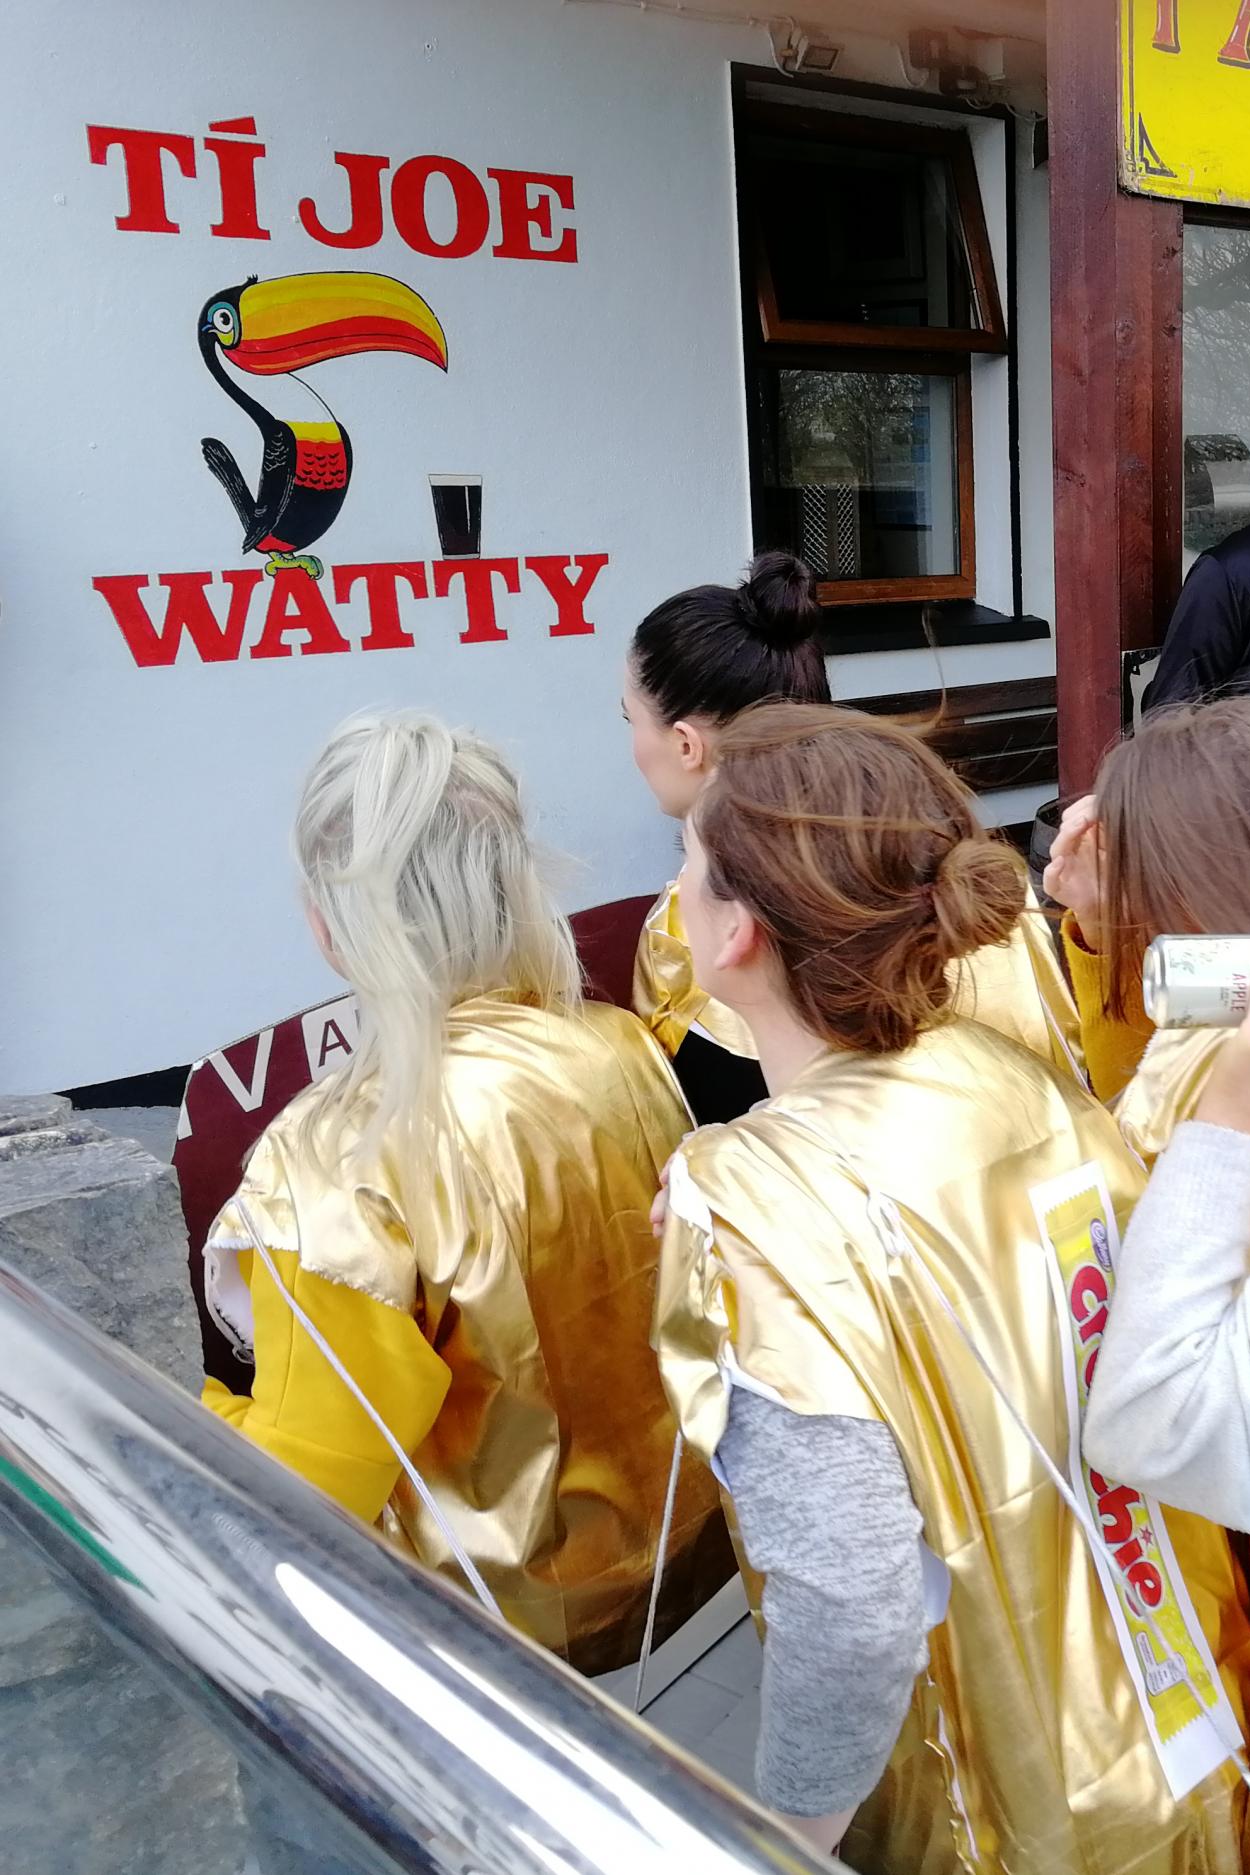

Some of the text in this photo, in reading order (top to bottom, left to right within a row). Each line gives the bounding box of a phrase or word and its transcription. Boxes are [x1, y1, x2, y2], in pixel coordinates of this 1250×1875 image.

[86, 115, 579, 263] TÍ JOE
[92, 552, 609, 668] WATTY
[1230, 972, 1248, 1013] APPLE
